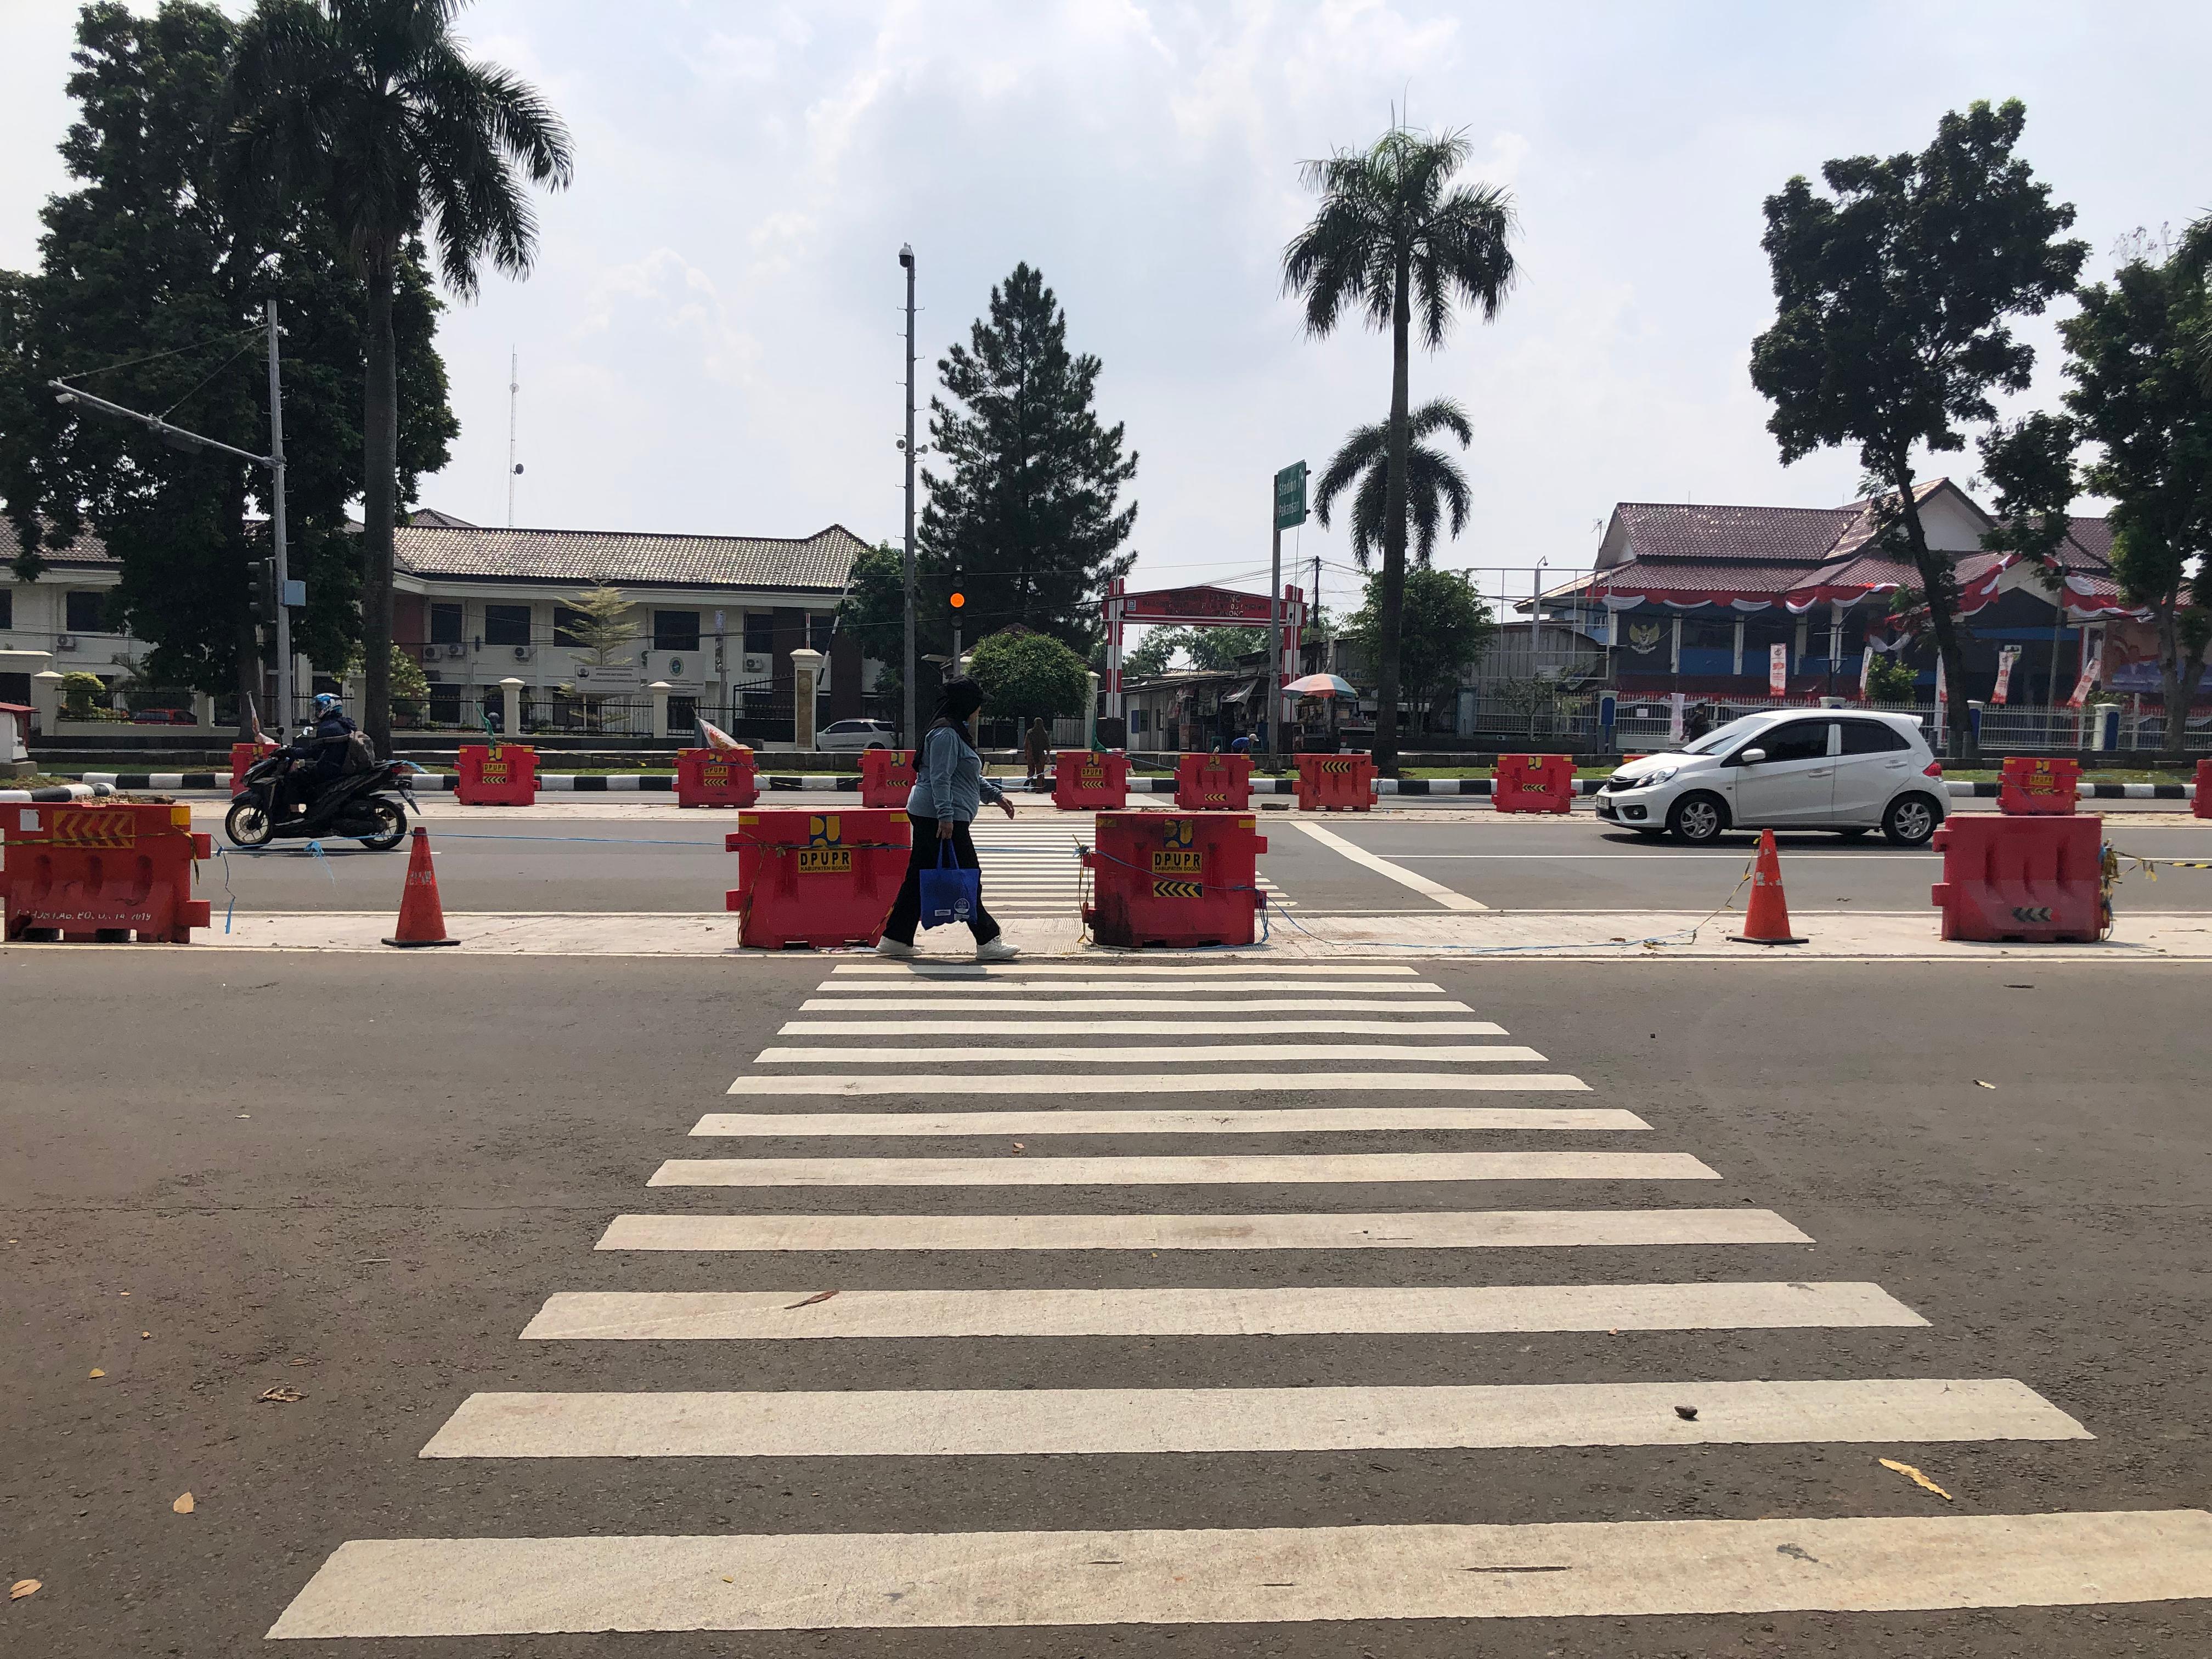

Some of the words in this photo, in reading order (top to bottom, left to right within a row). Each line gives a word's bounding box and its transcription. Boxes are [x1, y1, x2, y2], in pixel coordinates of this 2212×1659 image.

[1279, 479, 1297, 496] Stadion
[800, 851, 850, 866] DPUPR
[1155, 853, 1200, 866] DPUPR
